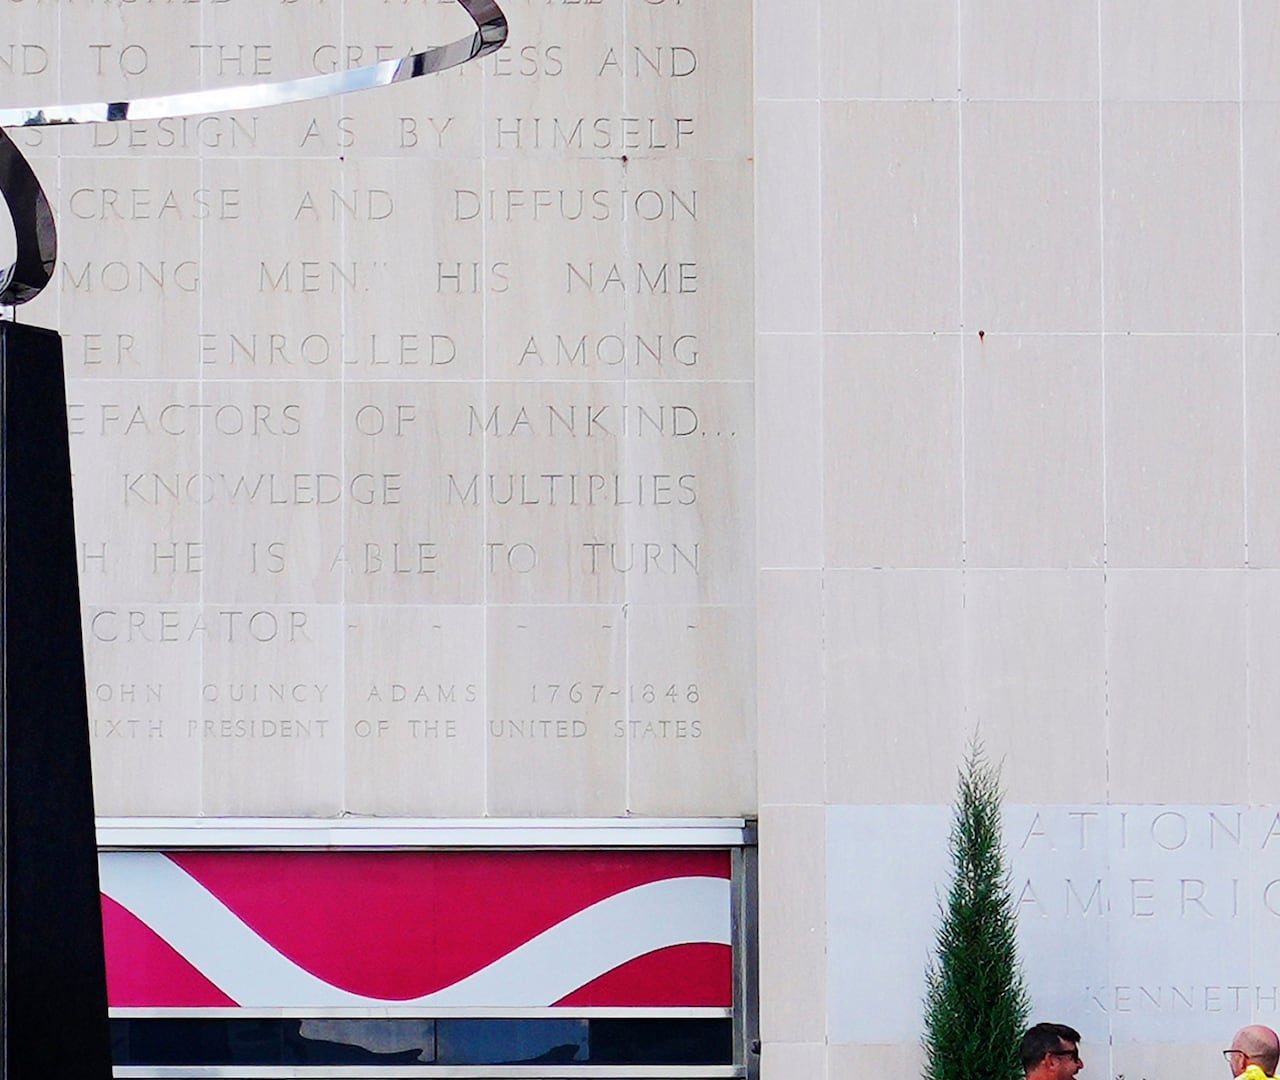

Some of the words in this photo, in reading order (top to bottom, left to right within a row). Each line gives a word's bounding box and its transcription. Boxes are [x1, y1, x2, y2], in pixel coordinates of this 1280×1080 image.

[89, 44, 149, 77] TO
[189, 44, 273, 77] THE
[598, 45, 699, 78] AND
[91, 116, 259, 148] DESIGN
[300, 117, 355, 149] AS
[398, 117, 454, 149] BY
[495, 117, 695, 149] HIMSELF
[52, 188, 240, 221] CREASE
[294, 190, 394, 221] AND
[454, 190, 699, 221] DIFFUSION
[62, 262, 200, 293] MONG
[436, 262, 511, 293] HIS
[565, 263, 698, 294] NAME
[198, 334, 457, 366] ENROLLED
[517, 335, 699, 367] AMONG
[68, 404, 301, 437] EFACTORS
[354, 405, 417, 437] OF
[122, 474, 403, 506] KNOWLEDGE
[446, 474, 698, 506] MULTIPLIES
[151, 542, 204, 575] HE
[250, 542, 286, 575] IS
[329, 542, 438, 575] ABLE
[484, 543, 538, 574] TO
[582, 543, 701, 575] TURN
[92, 611, 313, 643] CREATOR
[96, 684, 164, 704] OHN
[202, 684, 329, 704] QUINCY
[366, 684, 477, 704] ADAMS
[187, 720, 330, 739] PRESIDENT
[353, 720, 390, 739] OF
[408, 720, 458, 739] THE
[489, 720, 589, 739] UNITED
[613, 720, 703, 739] STATES
